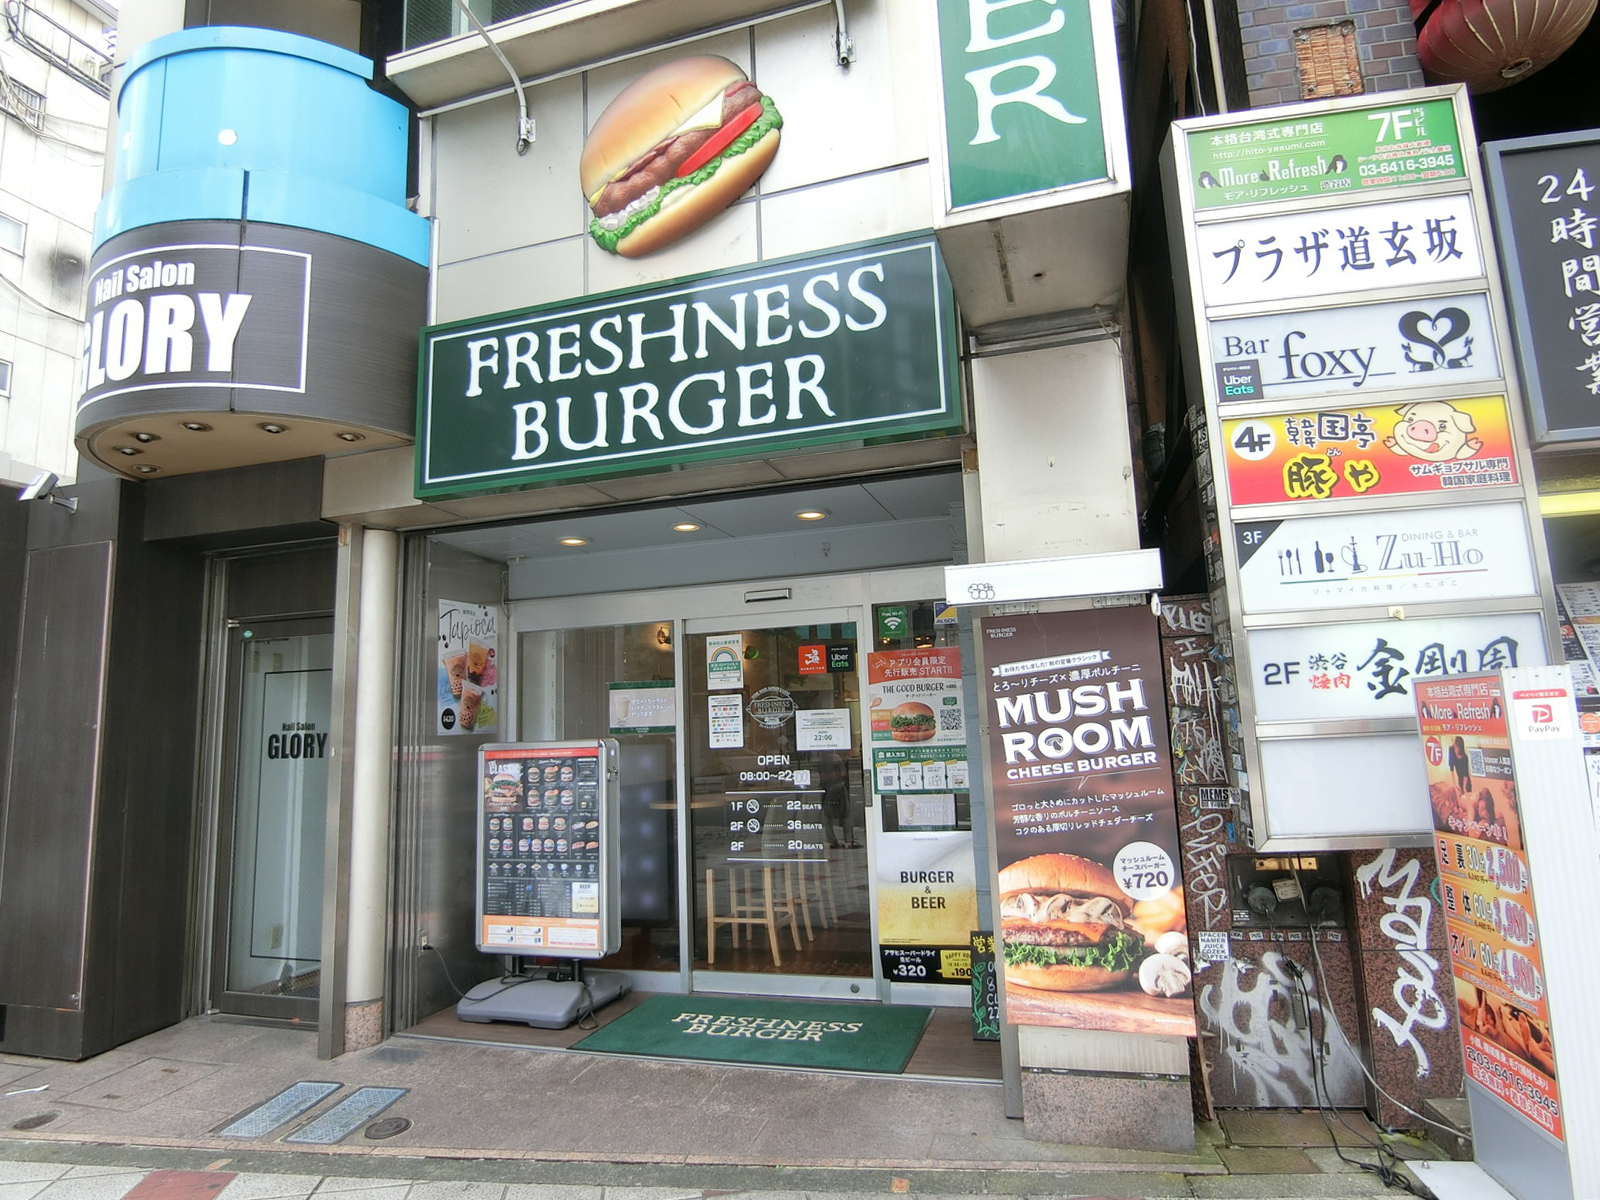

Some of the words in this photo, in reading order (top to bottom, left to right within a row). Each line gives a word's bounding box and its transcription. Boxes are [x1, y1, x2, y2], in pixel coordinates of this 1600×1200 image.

[1210, 122, 1323, 147] 本格台湾式専門店
[1367, 110, 1412, 142] 7F
[1219, 167, 1259, 186] More
[1268, 155, 1327, 180] Refresh
[1359, 154, 1454, 176] 03-6416-3945
[1223, 184, 1309, 200] モア・リフレッシュ
[1213, 215, 1463, 285] プラザ道玄坂
[95, 270, 124, 306] Nail
[126, 261, 195, 292] Salon
[466, 263, 887, 397] FRESHNESS
[1223, 336, 1269, 357] Bar
[1279, 330, 1376, 387] foxy
[1223, 375, 1252, 385] Uber
[1225, 384, 1254, 396] Eats
[511, 354, 836, 460] BURGER
[1234, 426, 1270, 453] 4F
[1284, 412, 1376, 449] 韓国亭
[1410, 457, 1510, 476] サムギョプサル専門
[1441, 472, 1512, 487] 韓国家庭料理
[1242, 530, 1262, 545] 3F
[1401, 530, 1443, 543] DINING
[1447, 530, 1454, 539] &
[1457, 528, 1478, 538] BAR
[1376, 534, 1484, 572] Zu-Ho
[440, 608, 496, 648] Tapioca
[832, 660, 849, 668] Eats
[1308, 652, 1348, 671] 渋谷
[1264, 661, 1300, 685] 2F
[1308, 672, 1351, 690] 焼肉
[882, 685, 895, 694] THE
[896, 684, 915, 693] GOOD
[917, 682, 944, 693] BURGER
[995, 678, 1148, 728] MUSH
[1430, 704, 1453, 719] More
[1456, 702, 1491, 719] Refresh
[282, 722, 296, 731] Nail
[296, 722, 316, 731] Salon
[1528, 725, 1560, 733] PayPay
[268, 732, 329, 760] GLORY
[1001, 716, 1155, 764] ROOM
[757, 755, 790, 766] OPEN
[1427, 743, 1441, 761] 7F
[1006, 762, 1075, 779] CHEESE
[1078, 752, 1157, 772] BURGER
[1200, 789, 1229, 800] MEMS
[730, 802, 743, 811] 1F
[786, 801, 801, 811] 22
[730, 822, 744, 832] 2F
[787, 821, 802, 830] 36
[731, 842, 745, 852] 2F
[788, 840, 803, 850] 20
[1120, 854, 1165, 864] マッシュルーム
[900, 871, 955, 883] BURGER
[1122, 871, 1168, 890] ¥720
[924, 885, 932, 894] &
[911, 896, 946, 909] BEER
[884, 949, 936, 957] アサヒスーパードライ
[893, 965, 927, 976] ¥320
[671, 1013, 863, 1033] FRESHNESS
[683, 1023, 823, 1042] BURGER
[1477, 1052, 1558, 1116] 03-6416-3945
